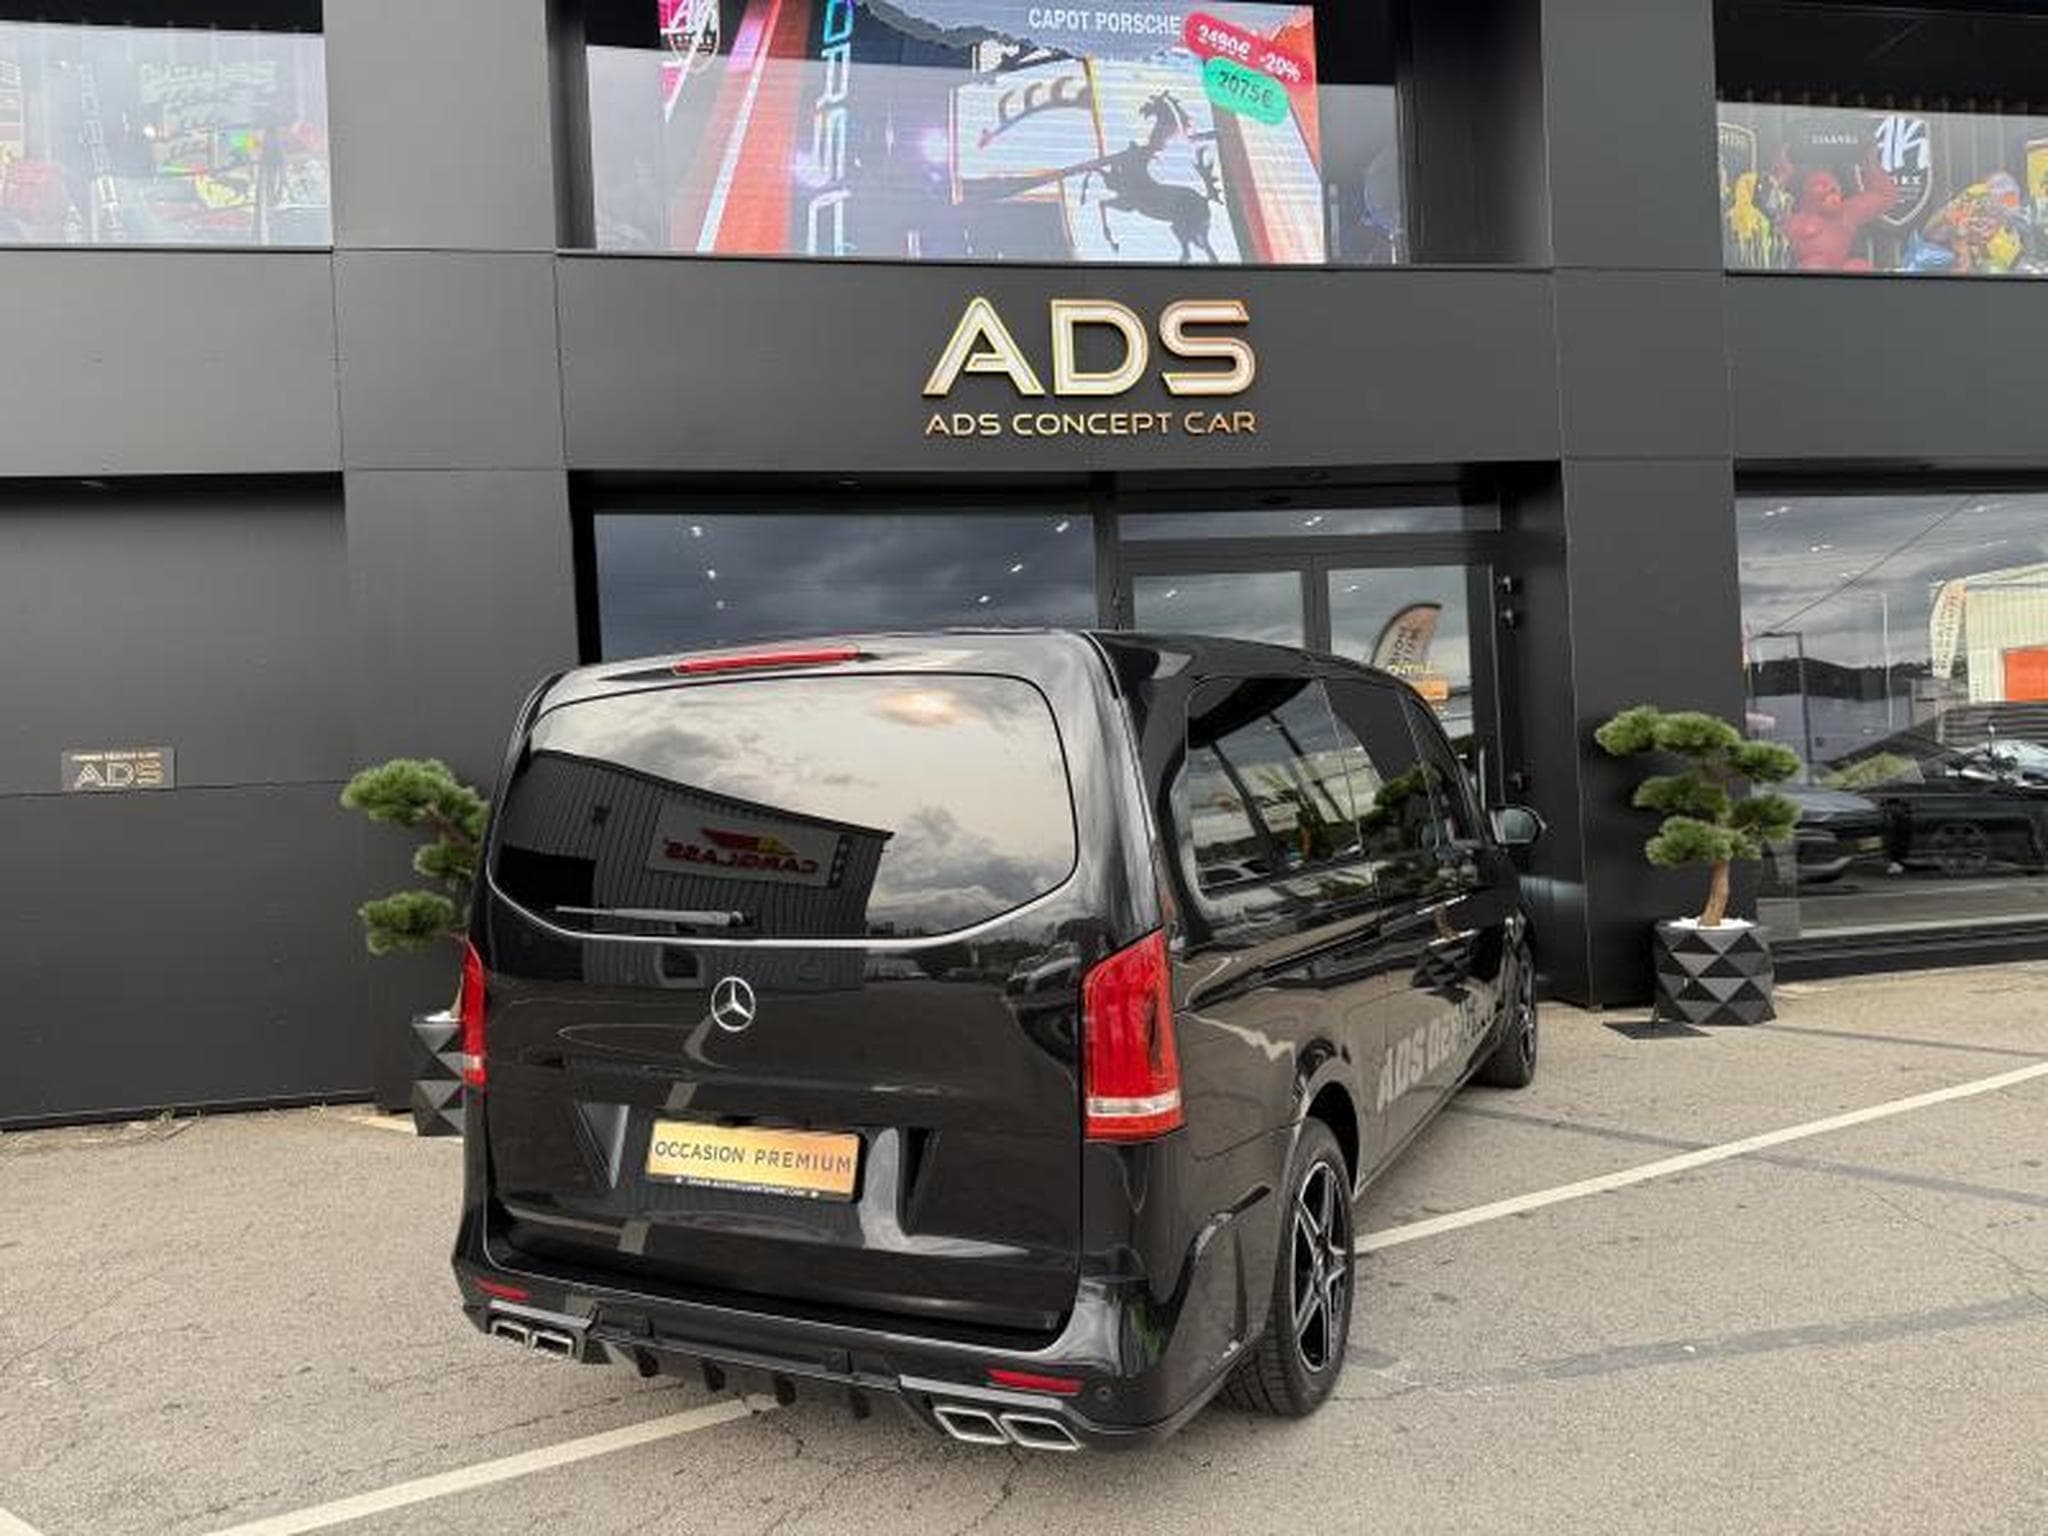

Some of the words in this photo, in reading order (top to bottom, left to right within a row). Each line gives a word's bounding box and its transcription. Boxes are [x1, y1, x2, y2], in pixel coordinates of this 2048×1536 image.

[1028, 8, 1090, 31] CAPOT
[1096, 11, 1181, 34] PORSCHE
[1219, 69, 1274, 108] 2075€
[922, 296, 1256, 396] ADS
[925, 413, 1001, 436] ADS
[1012, 412, 1173, 435] CONCEPT
[1184, 411, 1257, 434] CAR
[655, 1140, 744, 1163] OCCASION
[754, 1148, 851, 1172] PREMIUM
